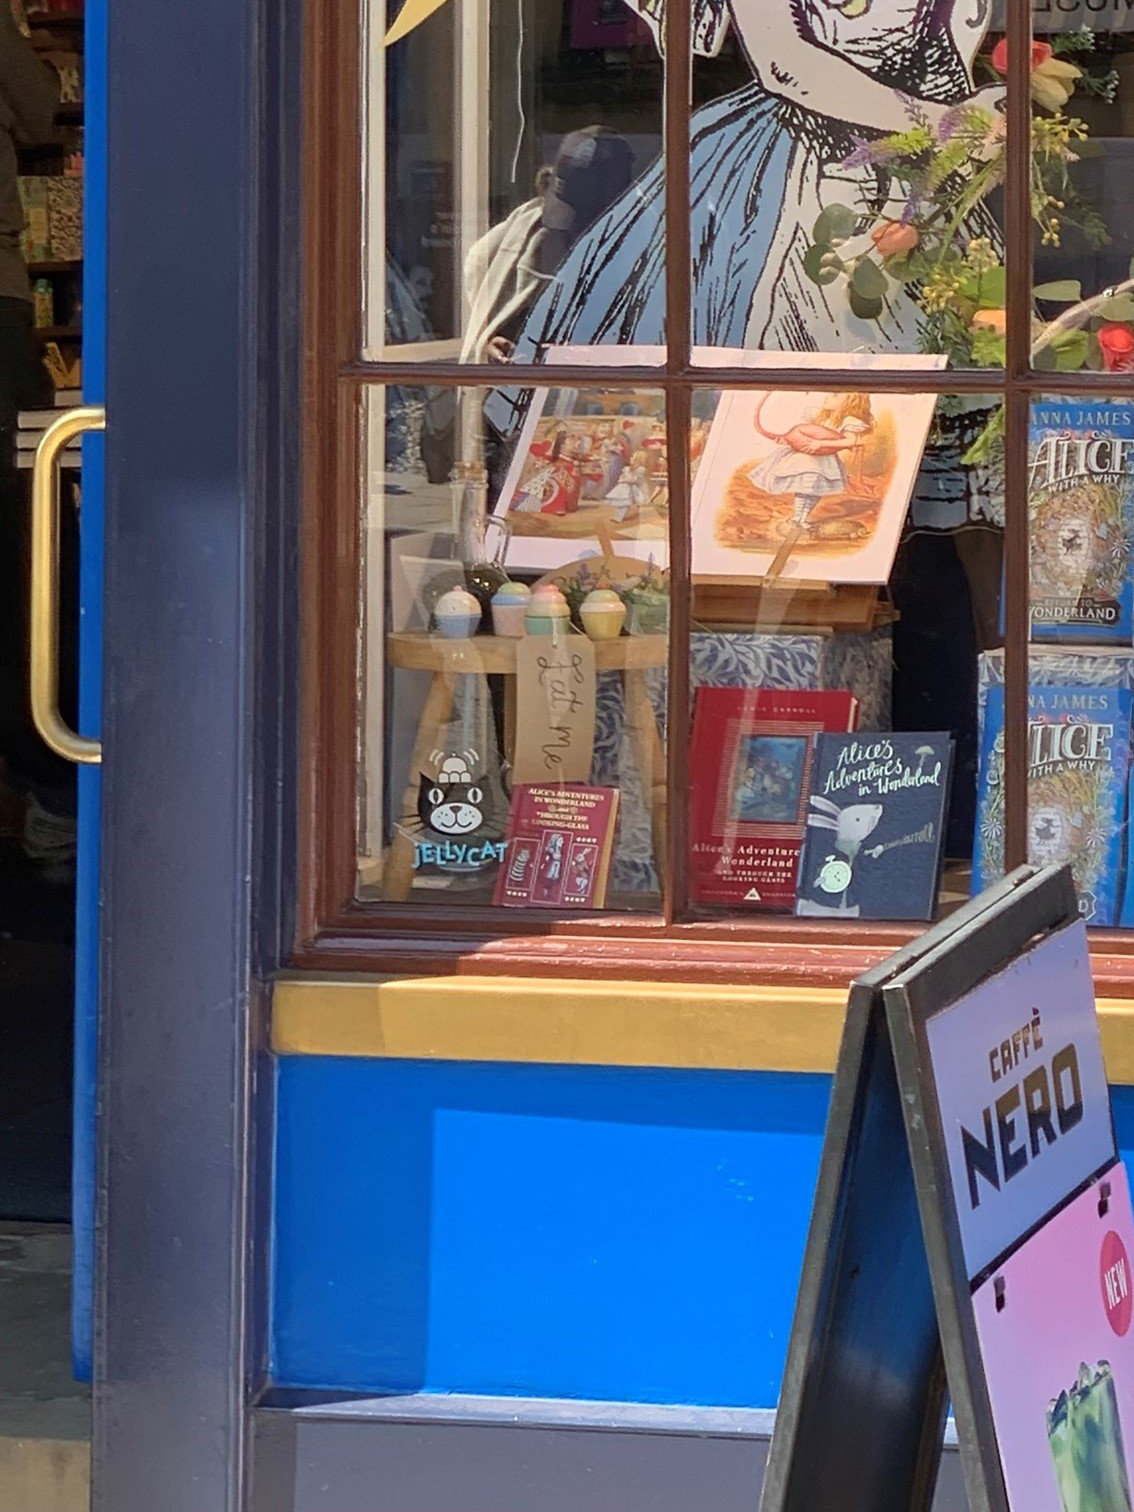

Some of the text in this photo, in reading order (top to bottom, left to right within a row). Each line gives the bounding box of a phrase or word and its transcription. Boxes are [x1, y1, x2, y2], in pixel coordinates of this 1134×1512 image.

[1076, 411, 1131, 426] JAMES
[1048, 474, 1120, 493] WITH A WHY
[1051, 694, 1108, 709] JAMES
[1028, 718, 1113, 768] LICE
[836, 739, 894, 771] Alice's
[1056, 762, 1064, 772] A
[1067, 760, 1096, 771] WHY
[823, 758, 903, 795] Adventures
[858, 761, 941, 796] in Wonderland
[544, 798, 596, 808] WONDERLAND
[737, 846, 801, 856] Adventure
[721, 856, 794, 868] Wonderland
[960, 1042, 1084, 1211] NERO
[1103, 1257, 1129, 1310] NEW
